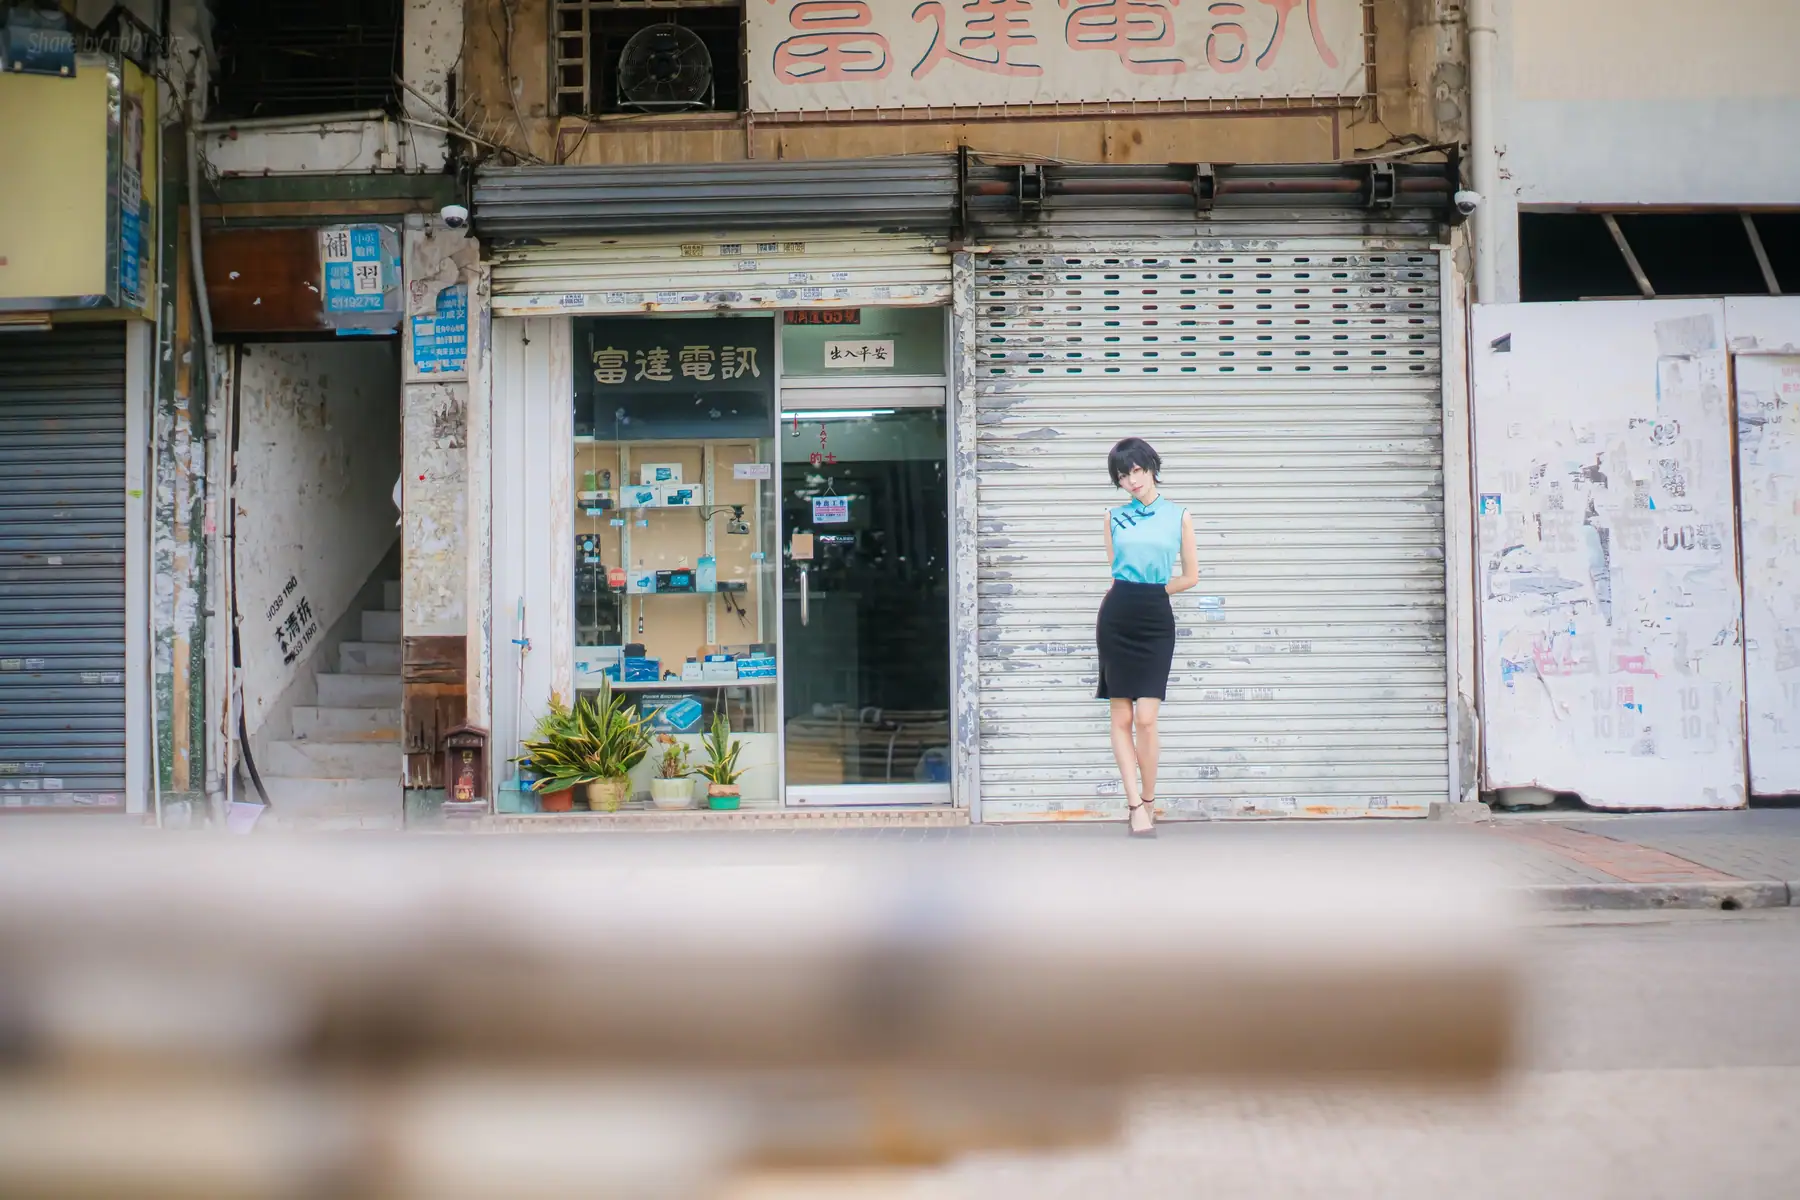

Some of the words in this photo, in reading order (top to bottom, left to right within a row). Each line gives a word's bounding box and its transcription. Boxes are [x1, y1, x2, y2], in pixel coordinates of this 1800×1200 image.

[830, 345, 888, 362] 出入平安
[593, 345, 761, 384] 富達電訊
[810, 452, 837, 465] 的士
